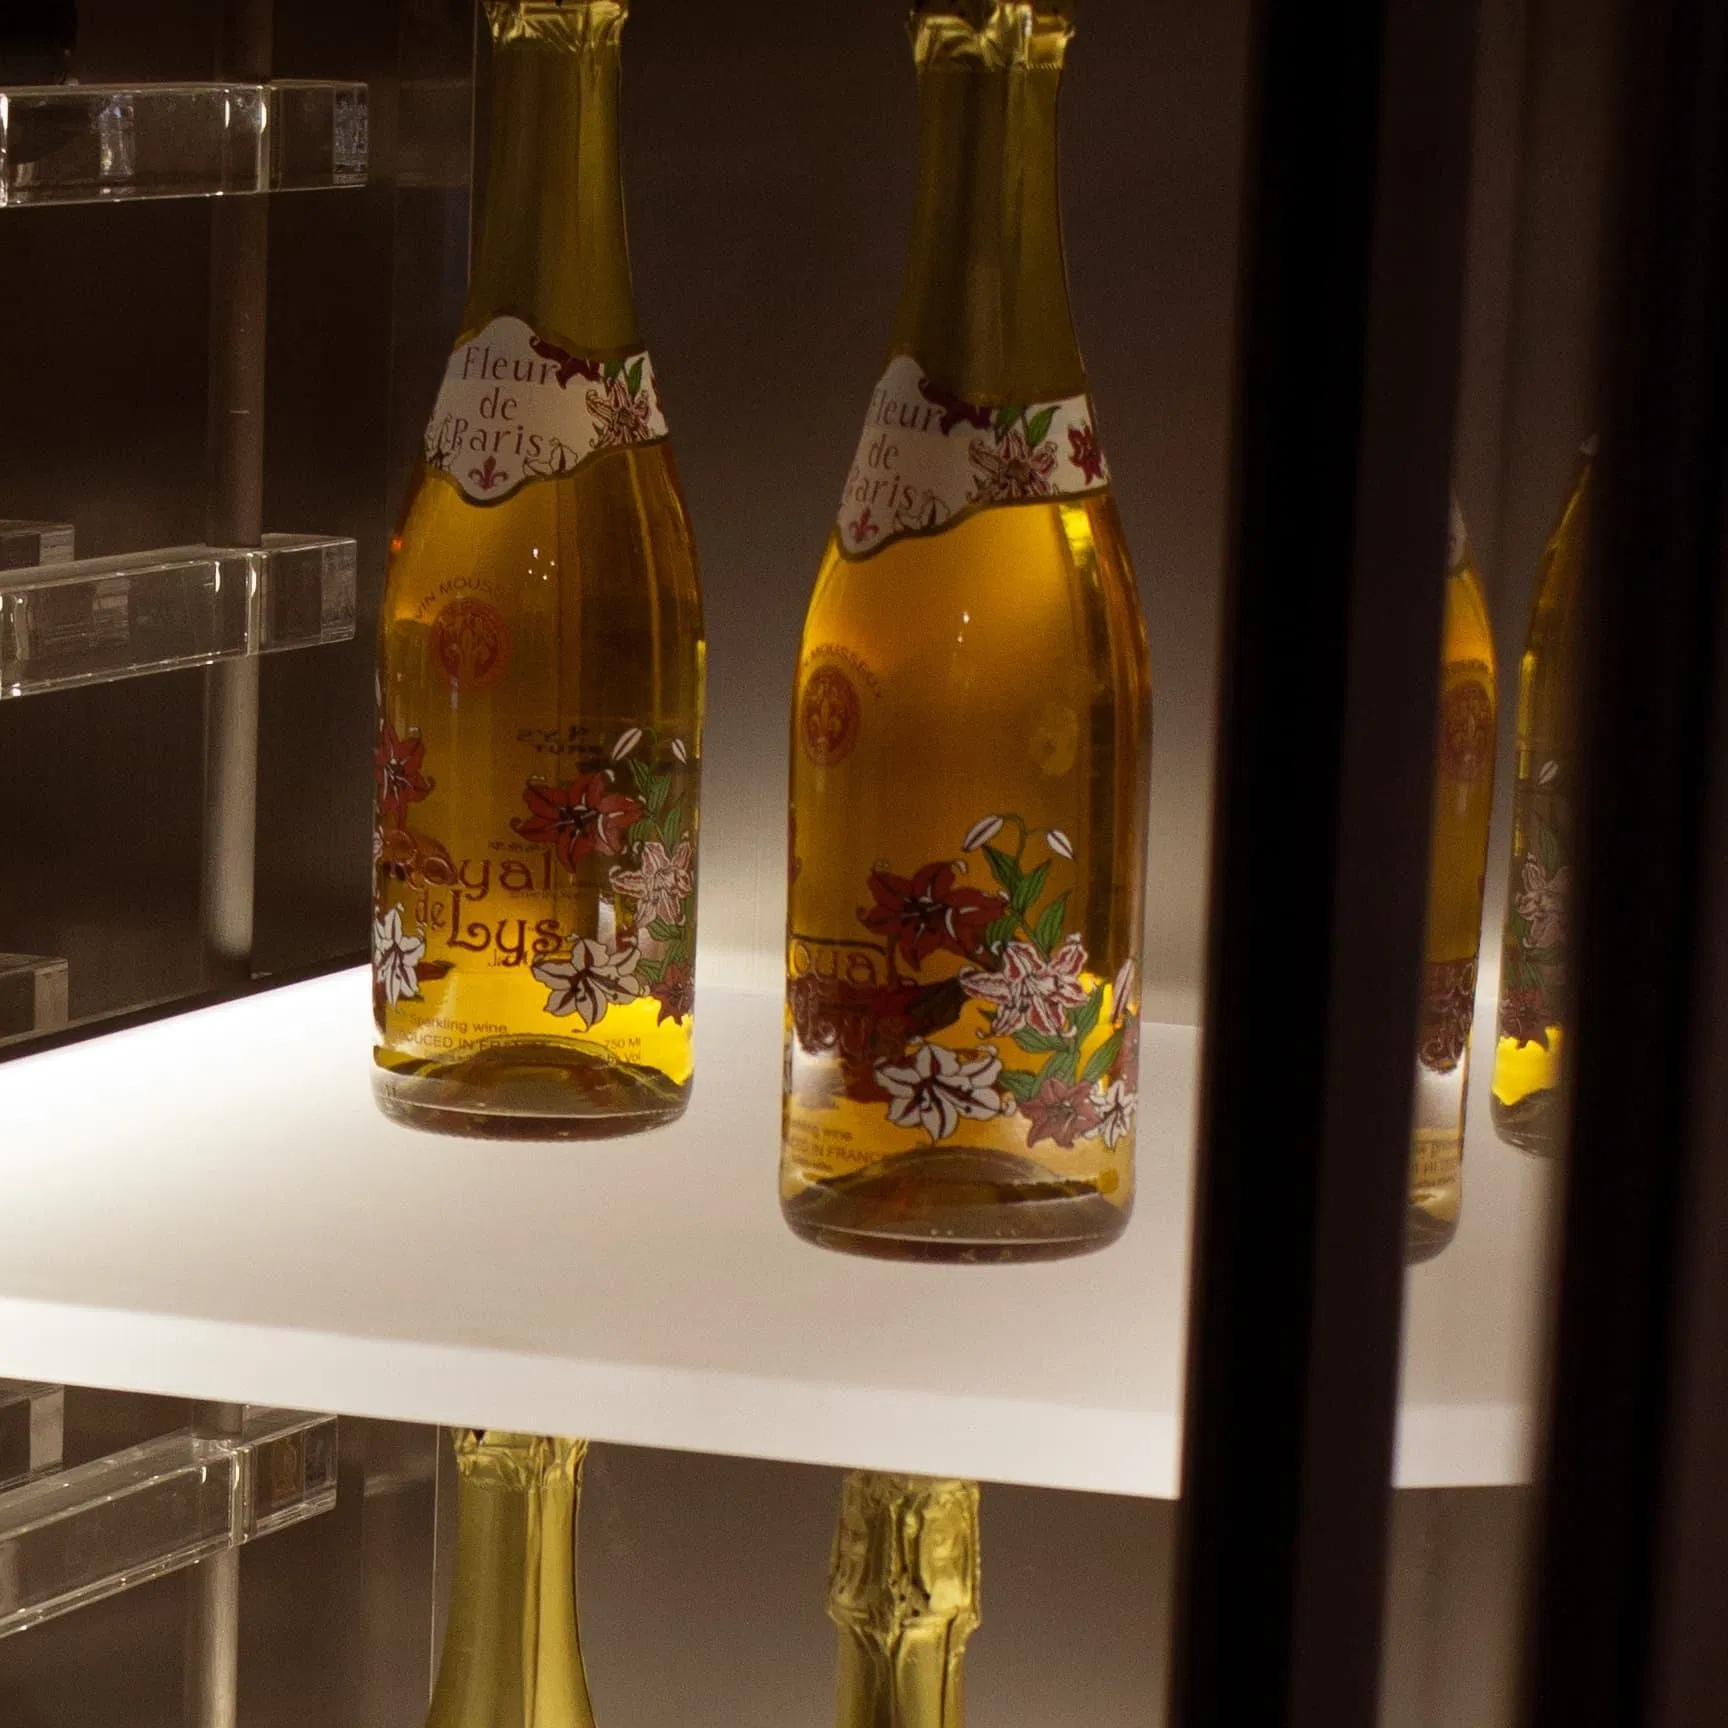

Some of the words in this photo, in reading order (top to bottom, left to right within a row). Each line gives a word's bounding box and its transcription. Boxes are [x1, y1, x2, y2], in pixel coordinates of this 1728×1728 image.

[463, 345, 558, 386] Fleur
[479, 387, 518, 421] de
[452, 418, 543, 457] Paris
[868, 434, 900, 471] de
[446, 889, 564, 967] Lys
[473, 1020, 508, 1034] wine
